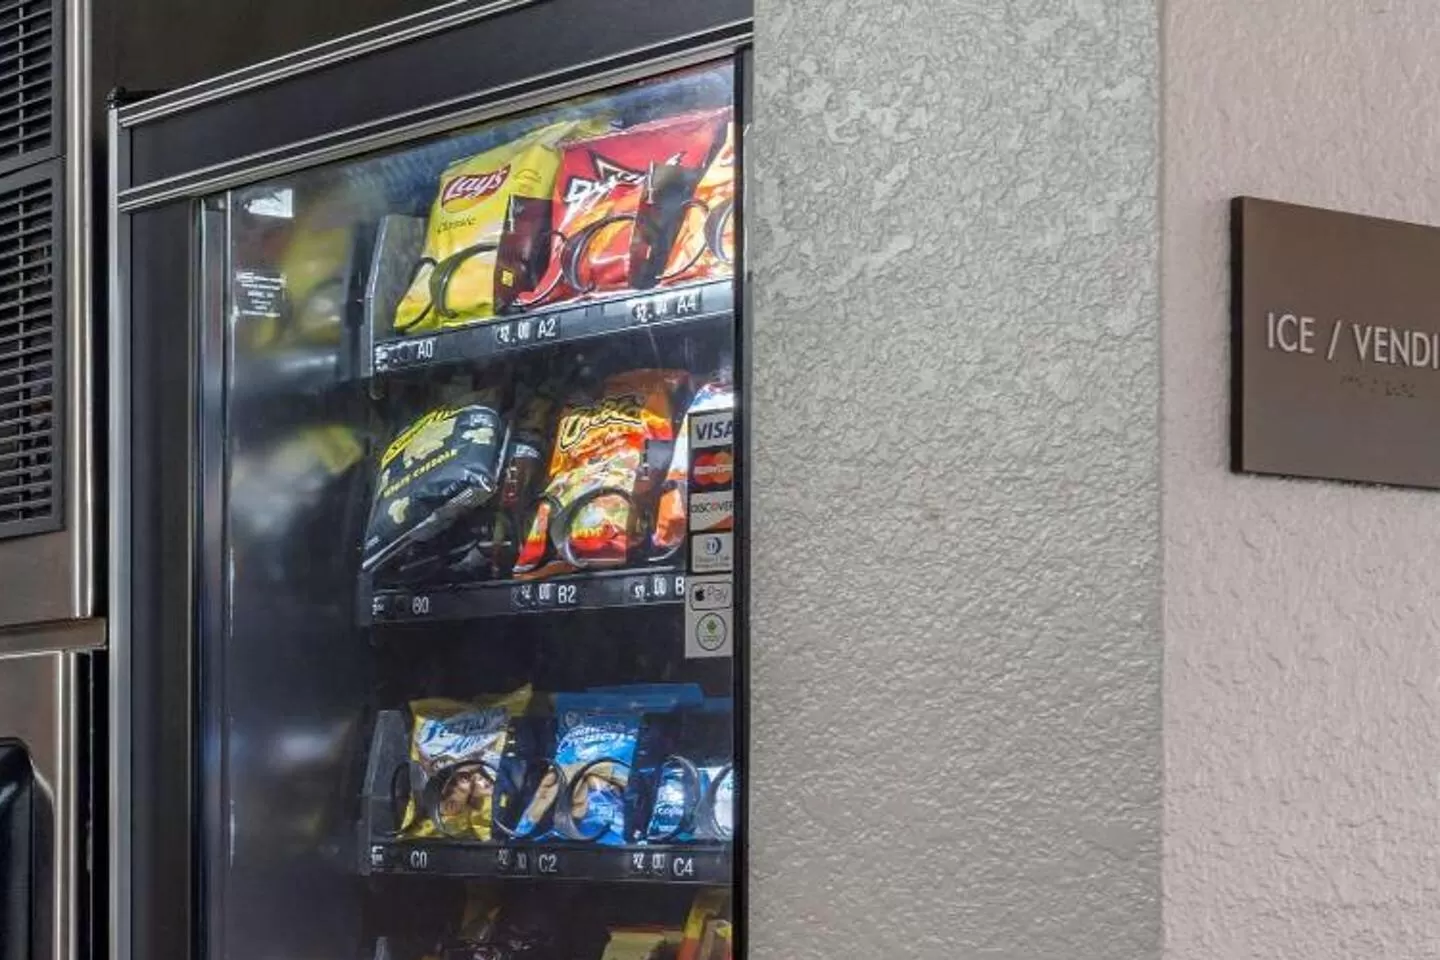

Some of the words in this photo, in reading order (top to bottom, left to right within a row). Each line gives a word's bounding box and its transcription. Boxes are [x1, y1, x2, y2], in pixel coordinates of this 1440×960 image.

[676, 294, 697, 314] A4
[536, 318, 556, 339] A2
[416, 340, 433, 360] A0
[1267, 312, 1316, 354] ICE
[1327, 320, 1341, 361] /
[1353, 323, 1440, 370] VENDI
[538, 853, 558, 873] C2
[673, 857, 695, 877] C4
